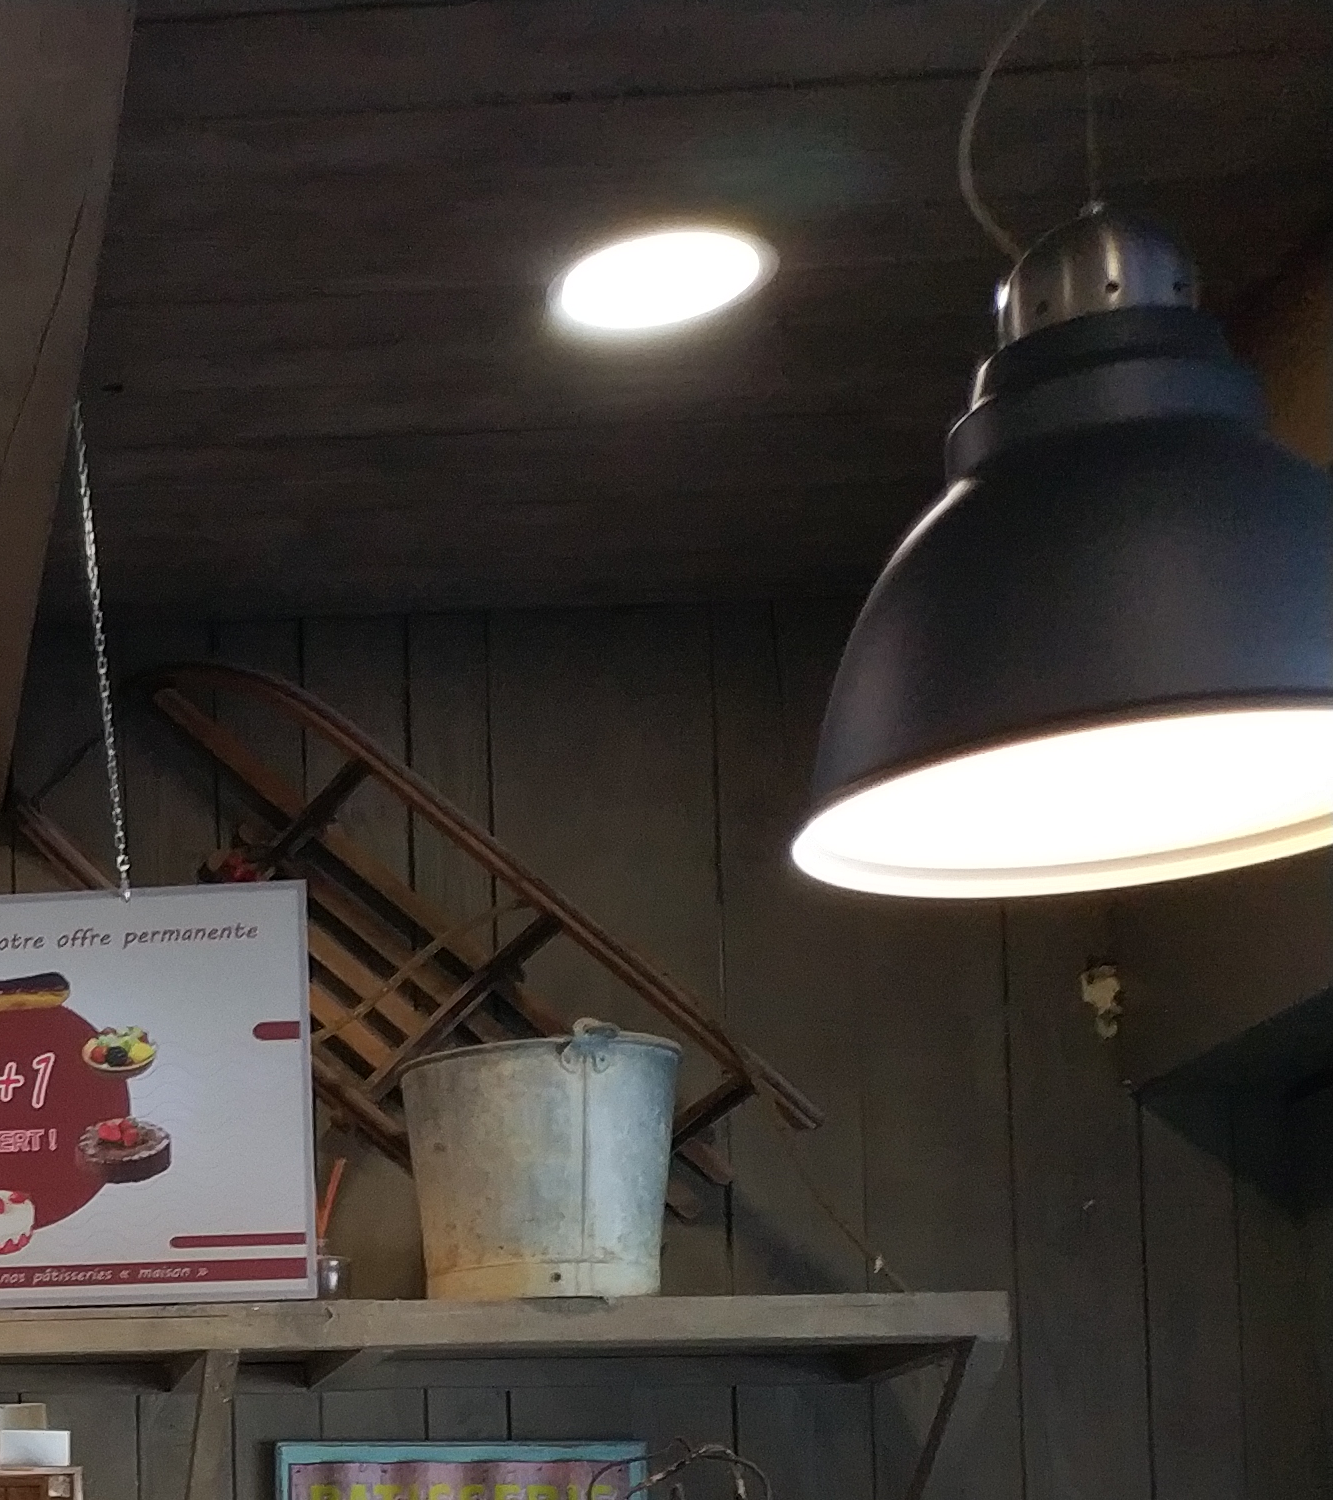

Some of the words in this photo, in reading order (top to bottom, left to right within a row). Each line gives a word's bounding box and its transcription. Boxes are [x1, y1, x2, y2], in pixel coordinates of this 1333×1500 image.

[57, 927, 112, 948] offre
[123, 921, 259, 949] permanente
[0, 1272, 26, 1284] nos
[32, 1268, 113, 1286] pâtisseries
[137, 1267, 192, 1279] maison
